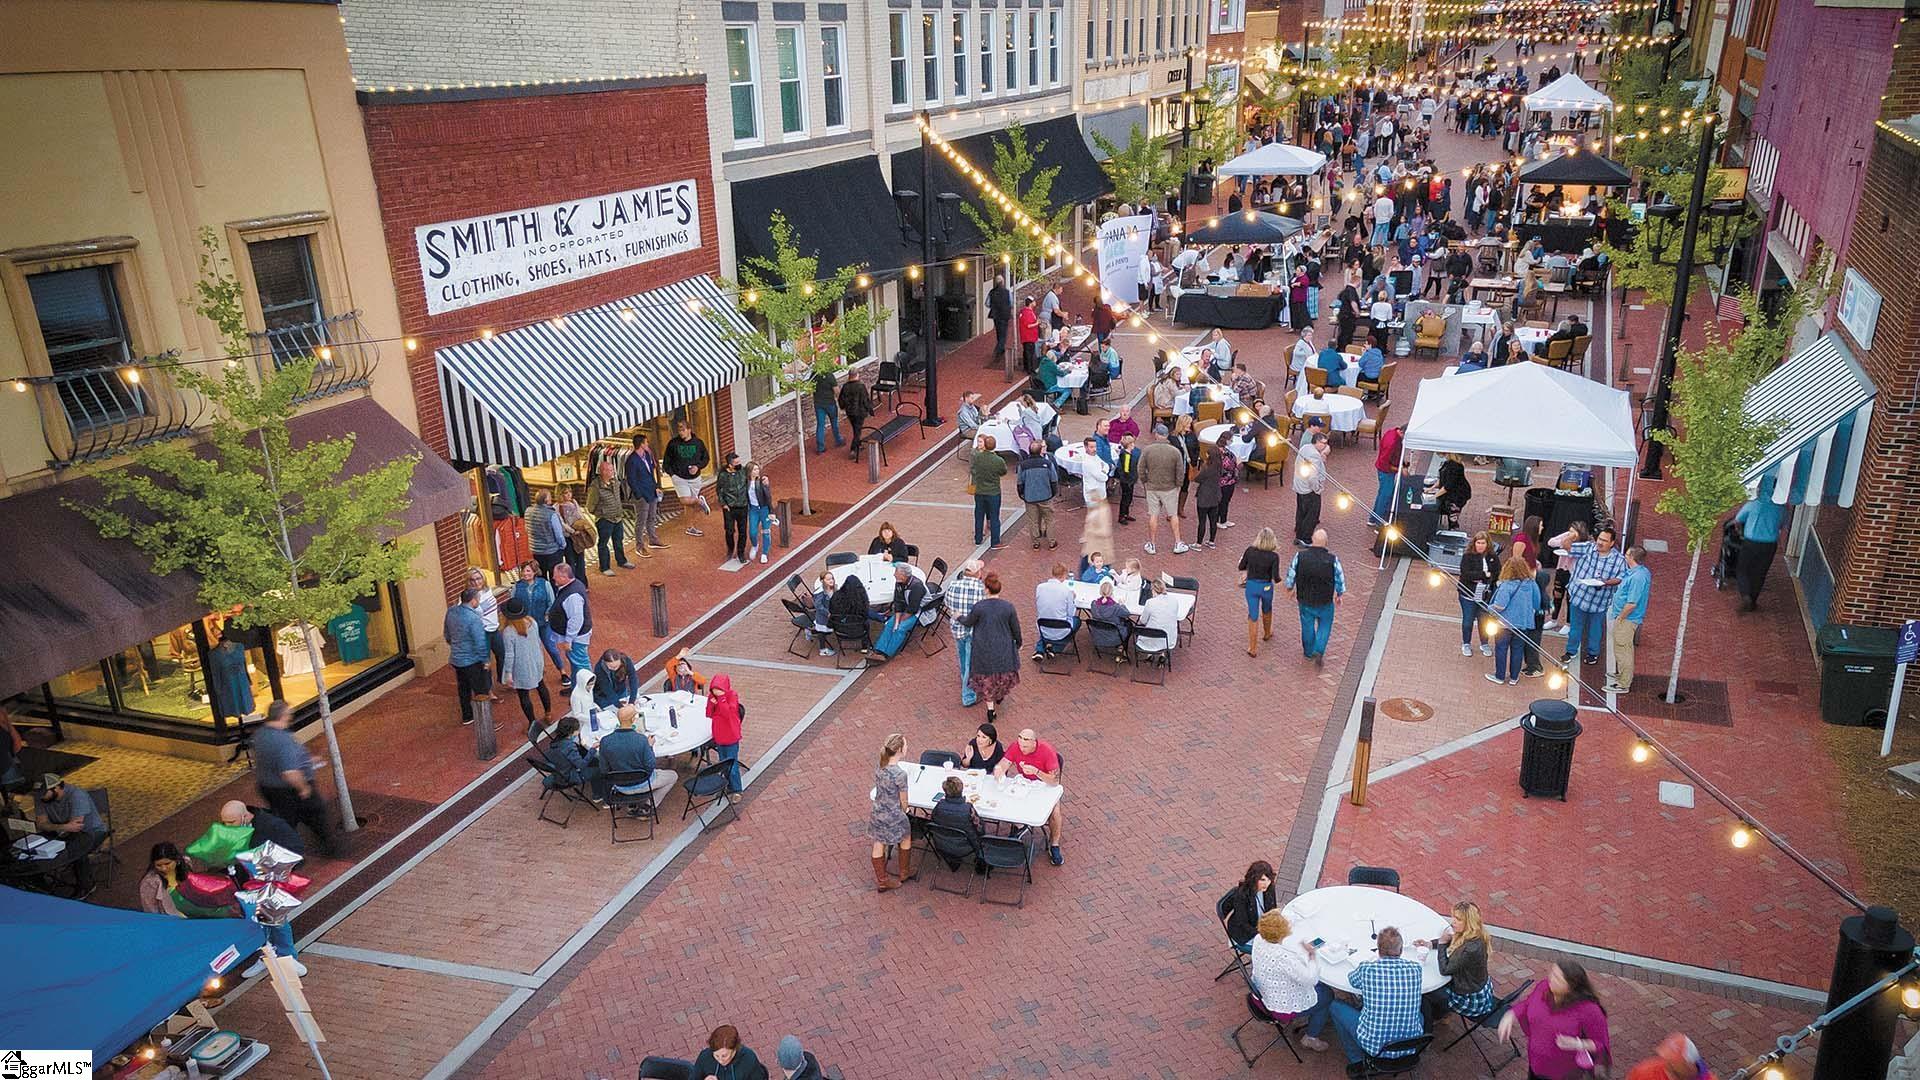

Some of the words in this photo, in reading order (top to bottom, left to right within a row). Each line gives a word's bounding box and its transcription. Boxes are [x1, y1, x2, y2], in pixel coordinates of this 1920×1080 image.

[424, 211, 543, 280] SMITH
[553, 204, 581, 238] &
[592, 184, 693, 230] JAMES
[442, 271, 520, 302] CLOTHING,
[528, 258, 573, 282] SHOES,
[578, 249, 617, 269] HATS,
[625, 229, 690, 256] FURNISHINGS
[523, 229, 625, 258] INCORPORATED
